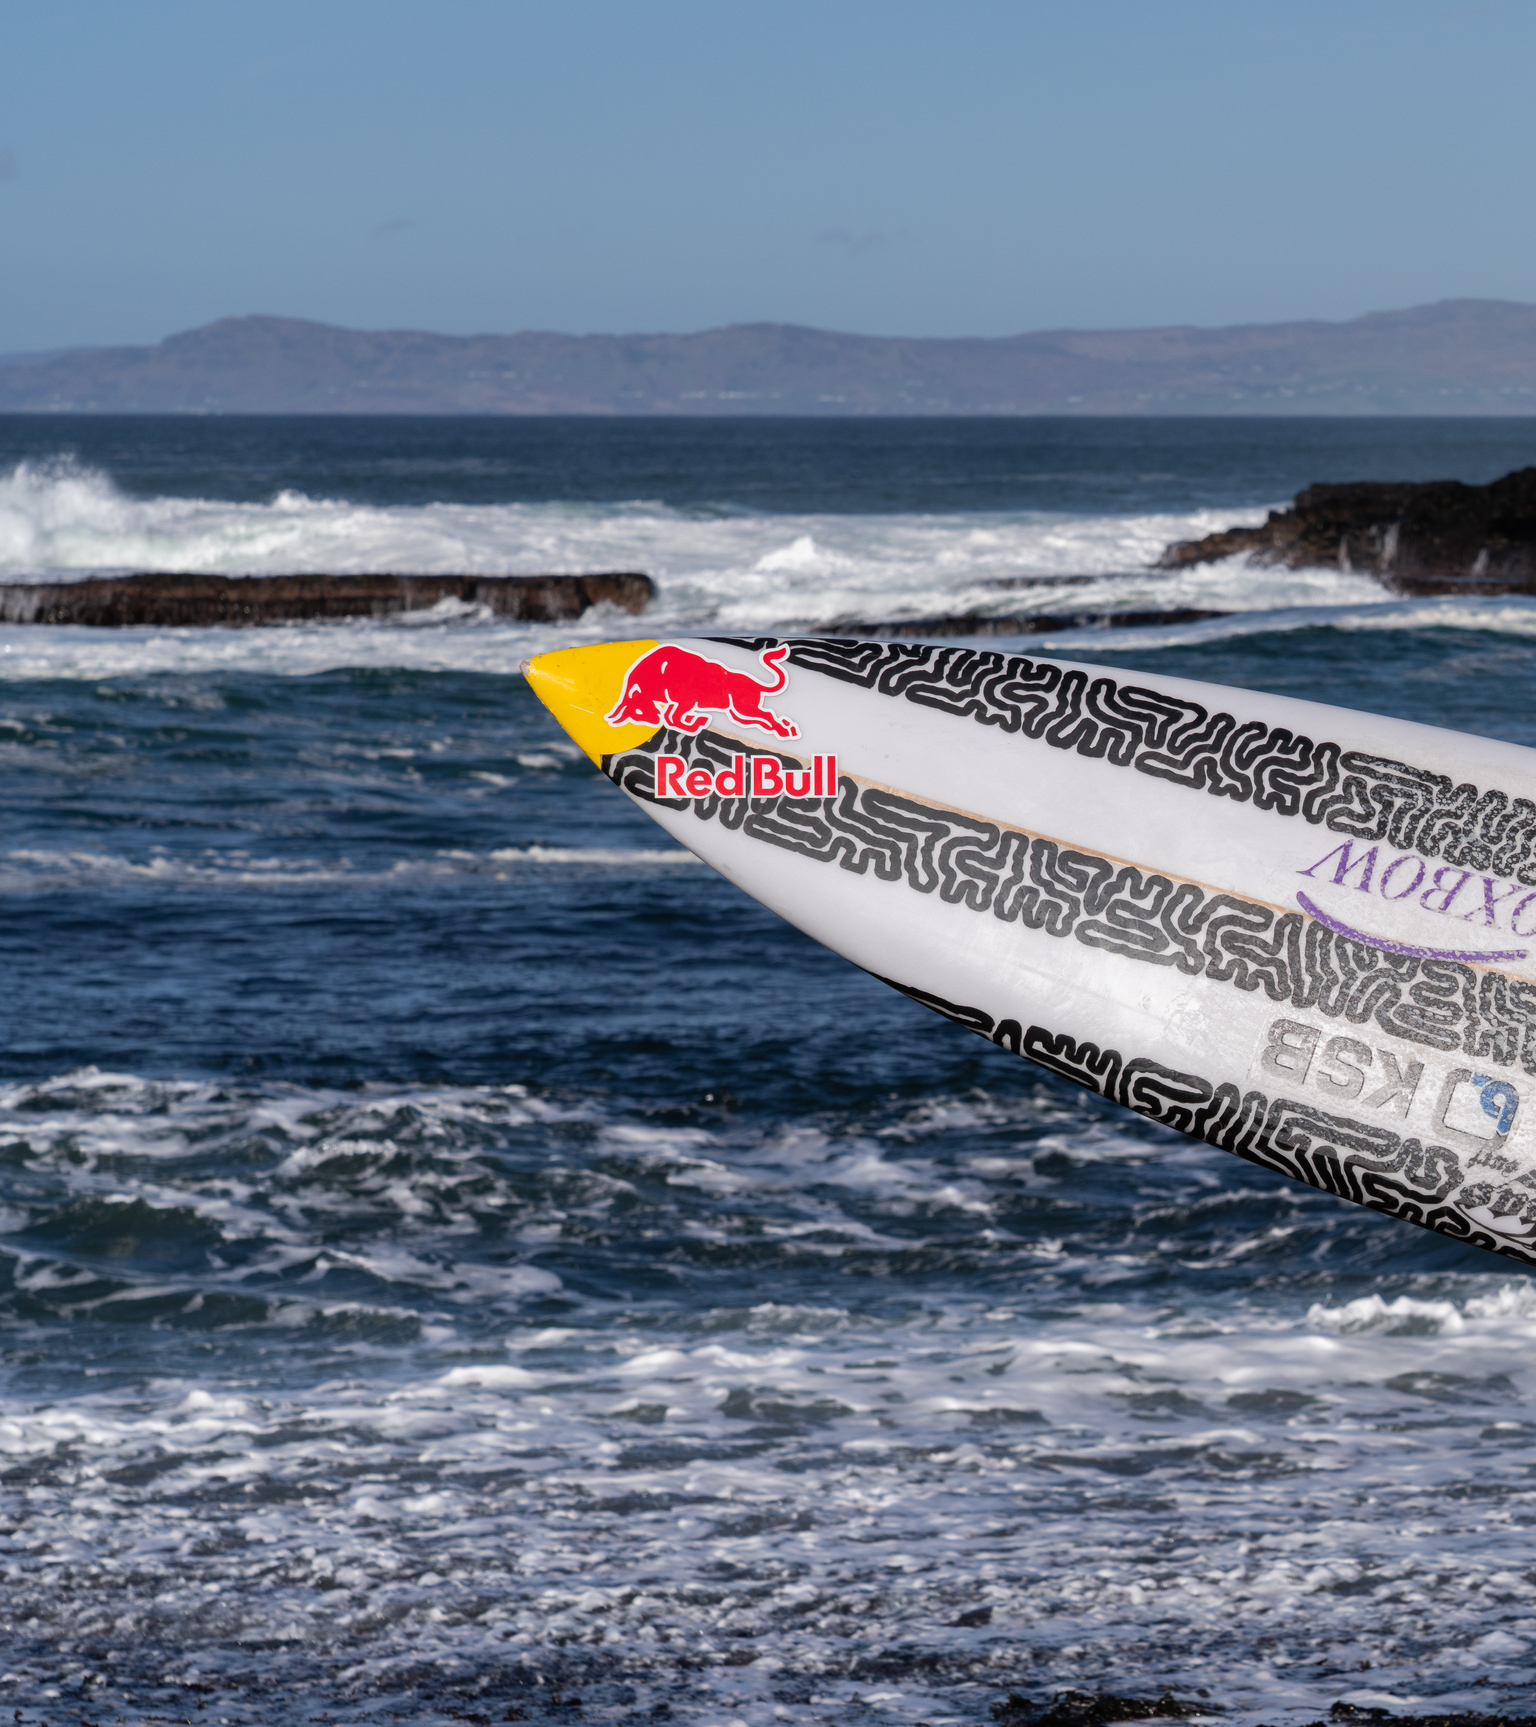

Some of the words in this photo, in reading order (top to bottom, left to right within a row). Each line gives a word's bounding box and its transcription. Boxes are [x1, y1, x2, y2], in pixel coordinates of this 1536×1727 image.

[655, 753, 746, 798] Red
[751, 753, 839, 798] Bull
[1261, 1018, 1425, 1118] KSB
